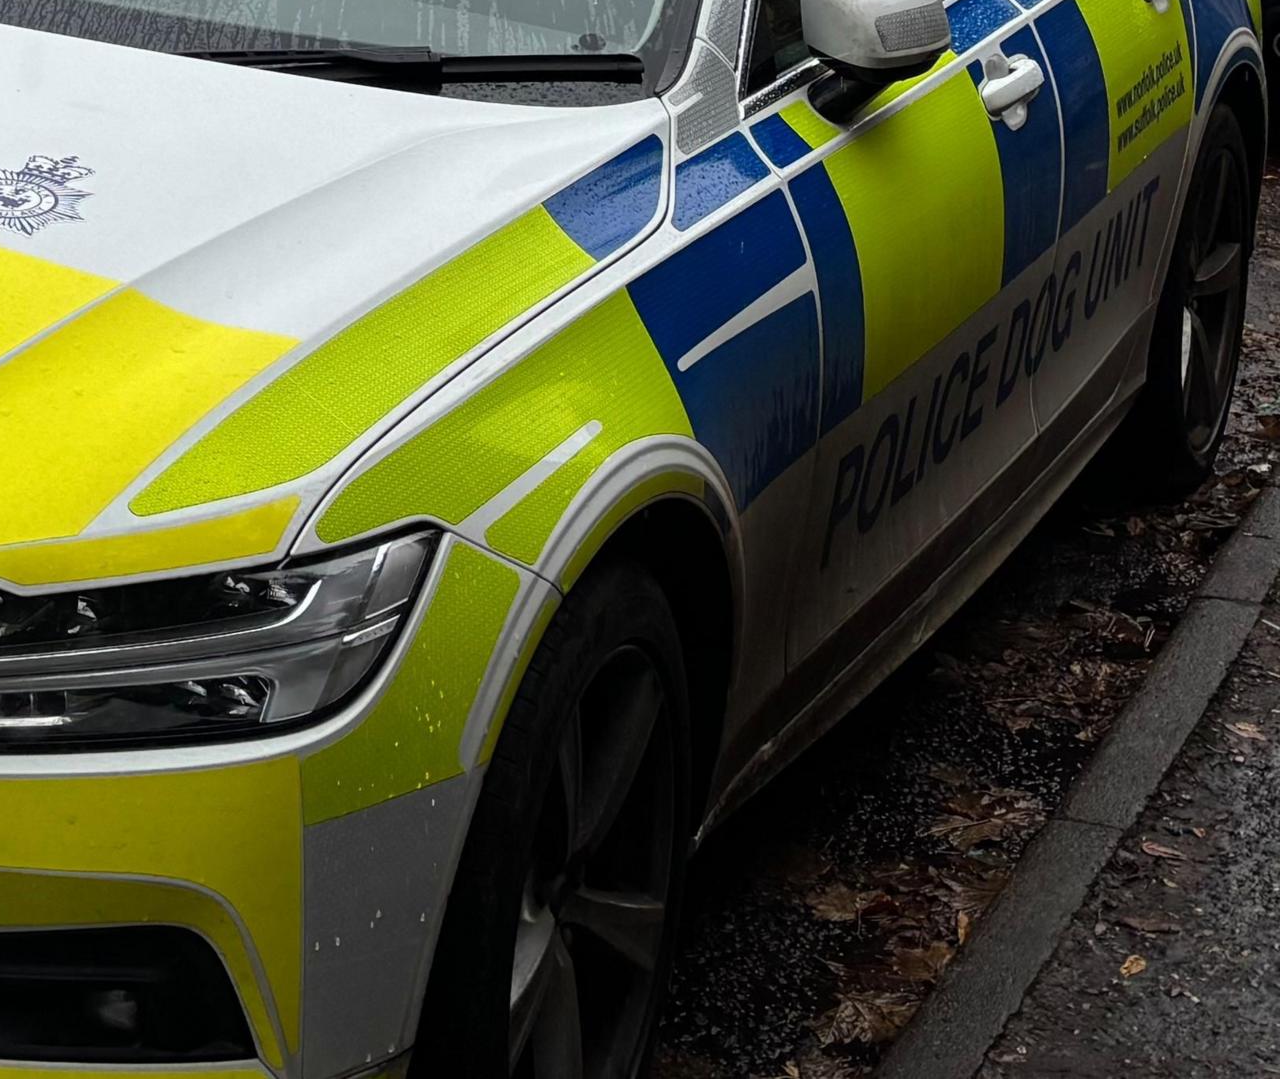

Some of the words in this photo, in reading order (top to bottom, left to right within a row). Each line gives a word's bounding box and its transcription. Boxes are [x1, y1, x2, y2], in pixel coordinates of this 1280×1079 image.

[820, 323, 1000, 573] POLICE
[996, 250, 1082, 409] DOG
[1083, 175, 1161, 320] UNIT
